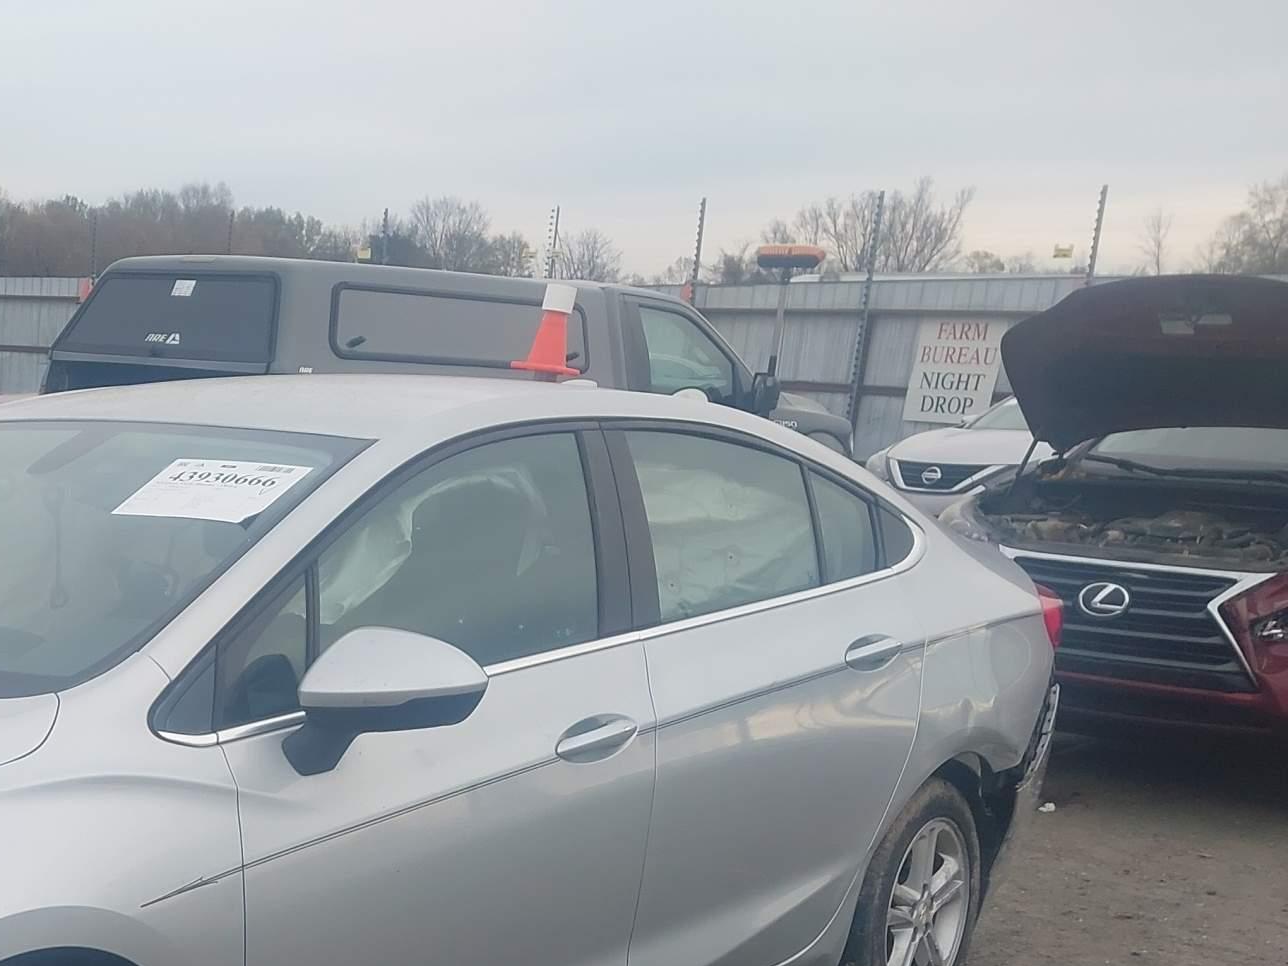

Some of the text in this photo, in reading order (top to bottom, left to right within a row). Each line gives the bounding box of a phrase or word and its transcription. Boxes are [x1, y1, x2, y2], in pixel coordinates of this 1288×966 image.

[937, 322, 990, 341] FARM
[920, 345, 999, 366] BUREAU
[920, 371, 987, 391] NIGHT
[920, 395, 975, 415] DROP
[168, 470, 279, 487] 43930666
